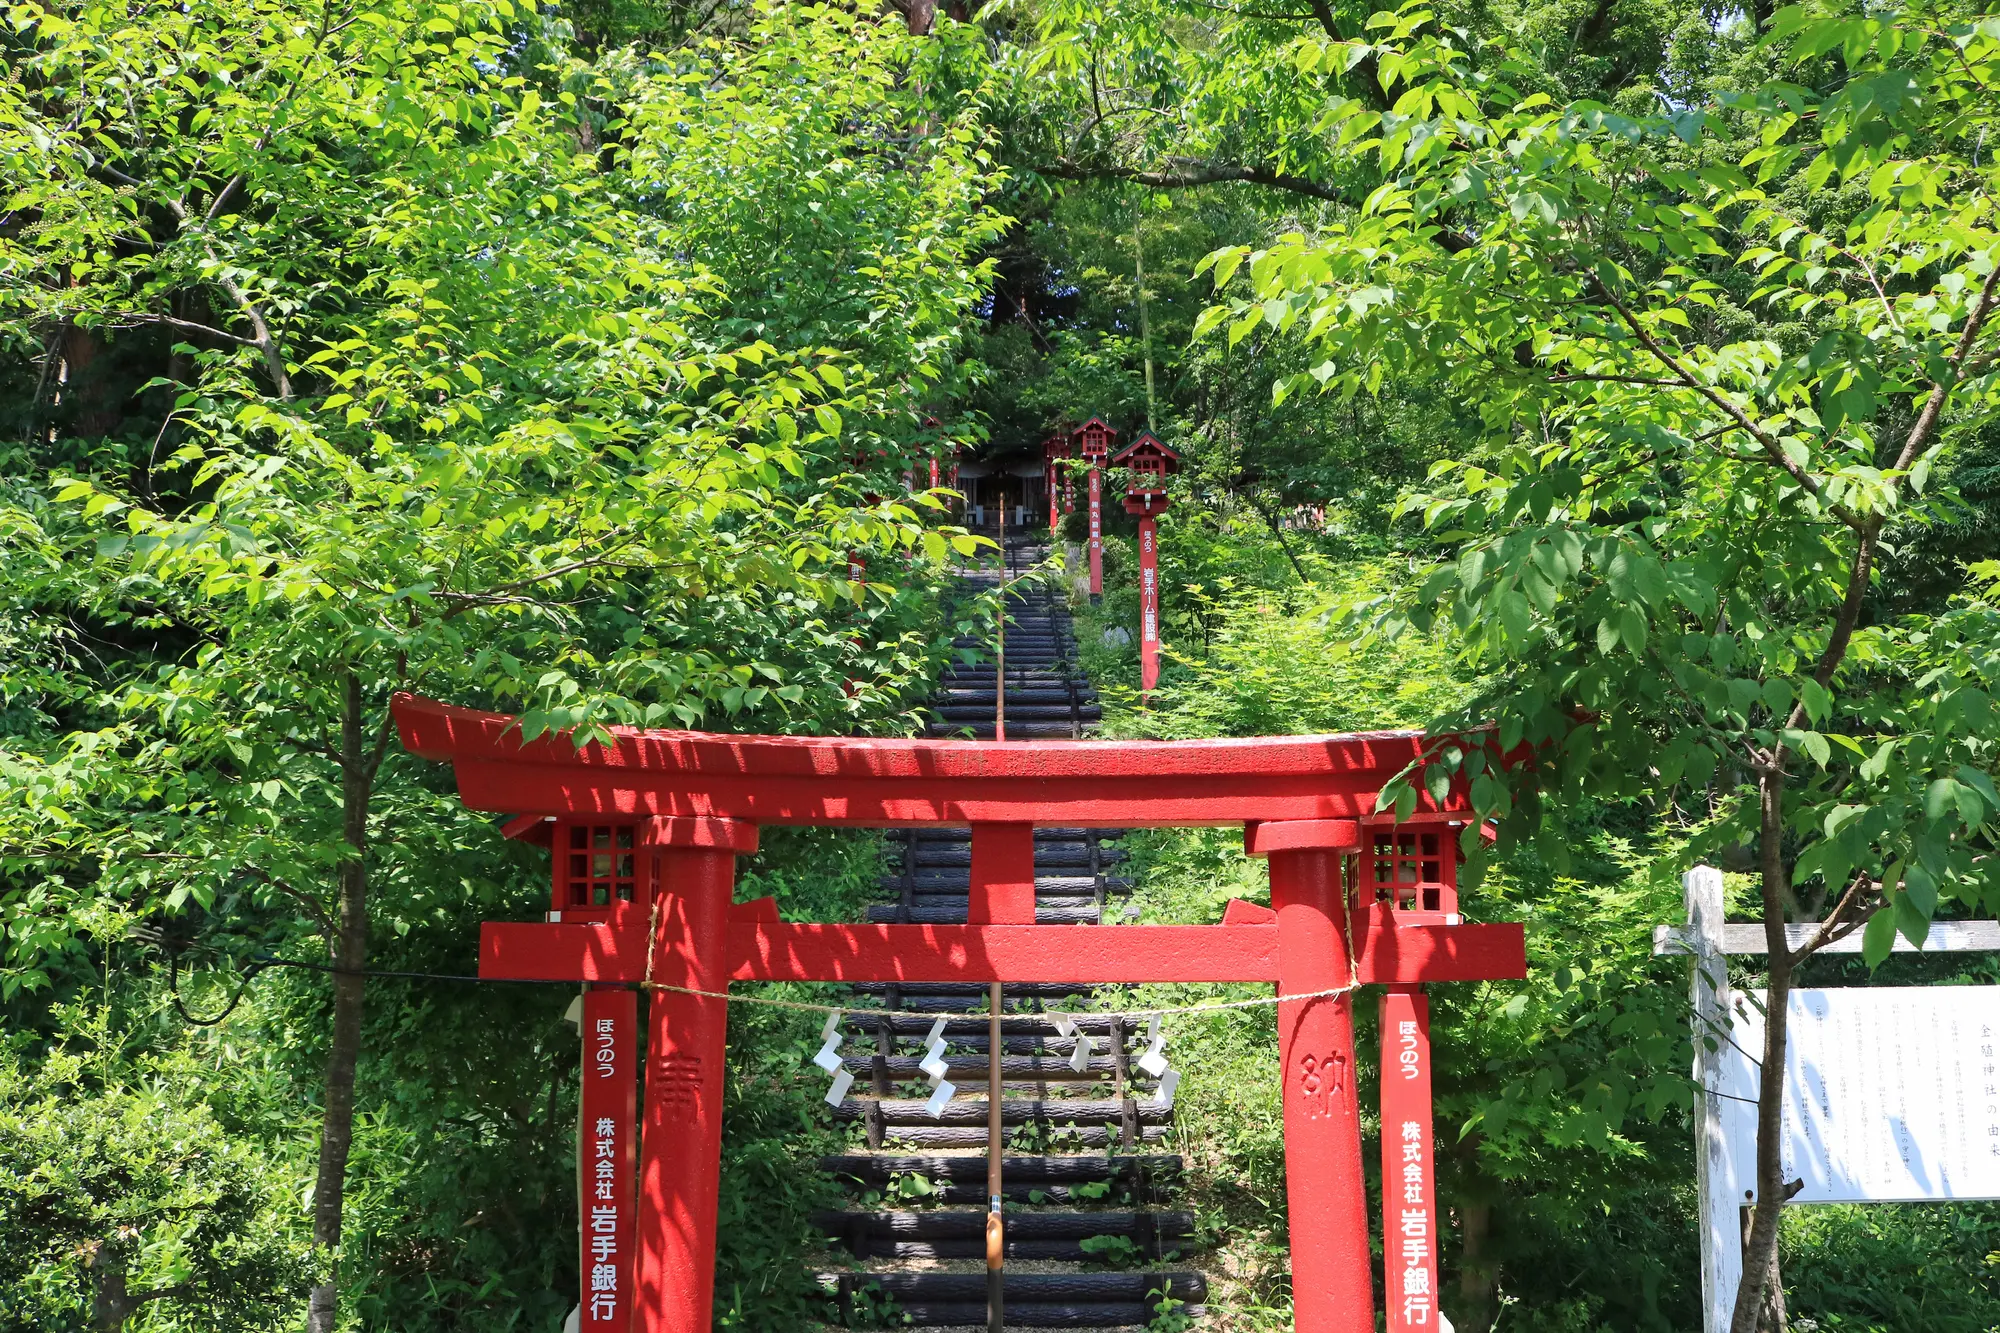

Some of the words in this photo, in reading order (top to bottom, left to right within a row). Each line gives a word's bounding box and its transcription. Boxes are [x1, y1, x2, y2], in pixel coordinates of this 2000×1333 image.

[596, 1019, 615, 1078] ほうのう
[1399, 1021, 1419, 1080] ほうのう
[590, 1117, 618, 1321] 株式会社岩手銀行
[1400, 1121, 1431, 1325] 株式会社岩手銀行
